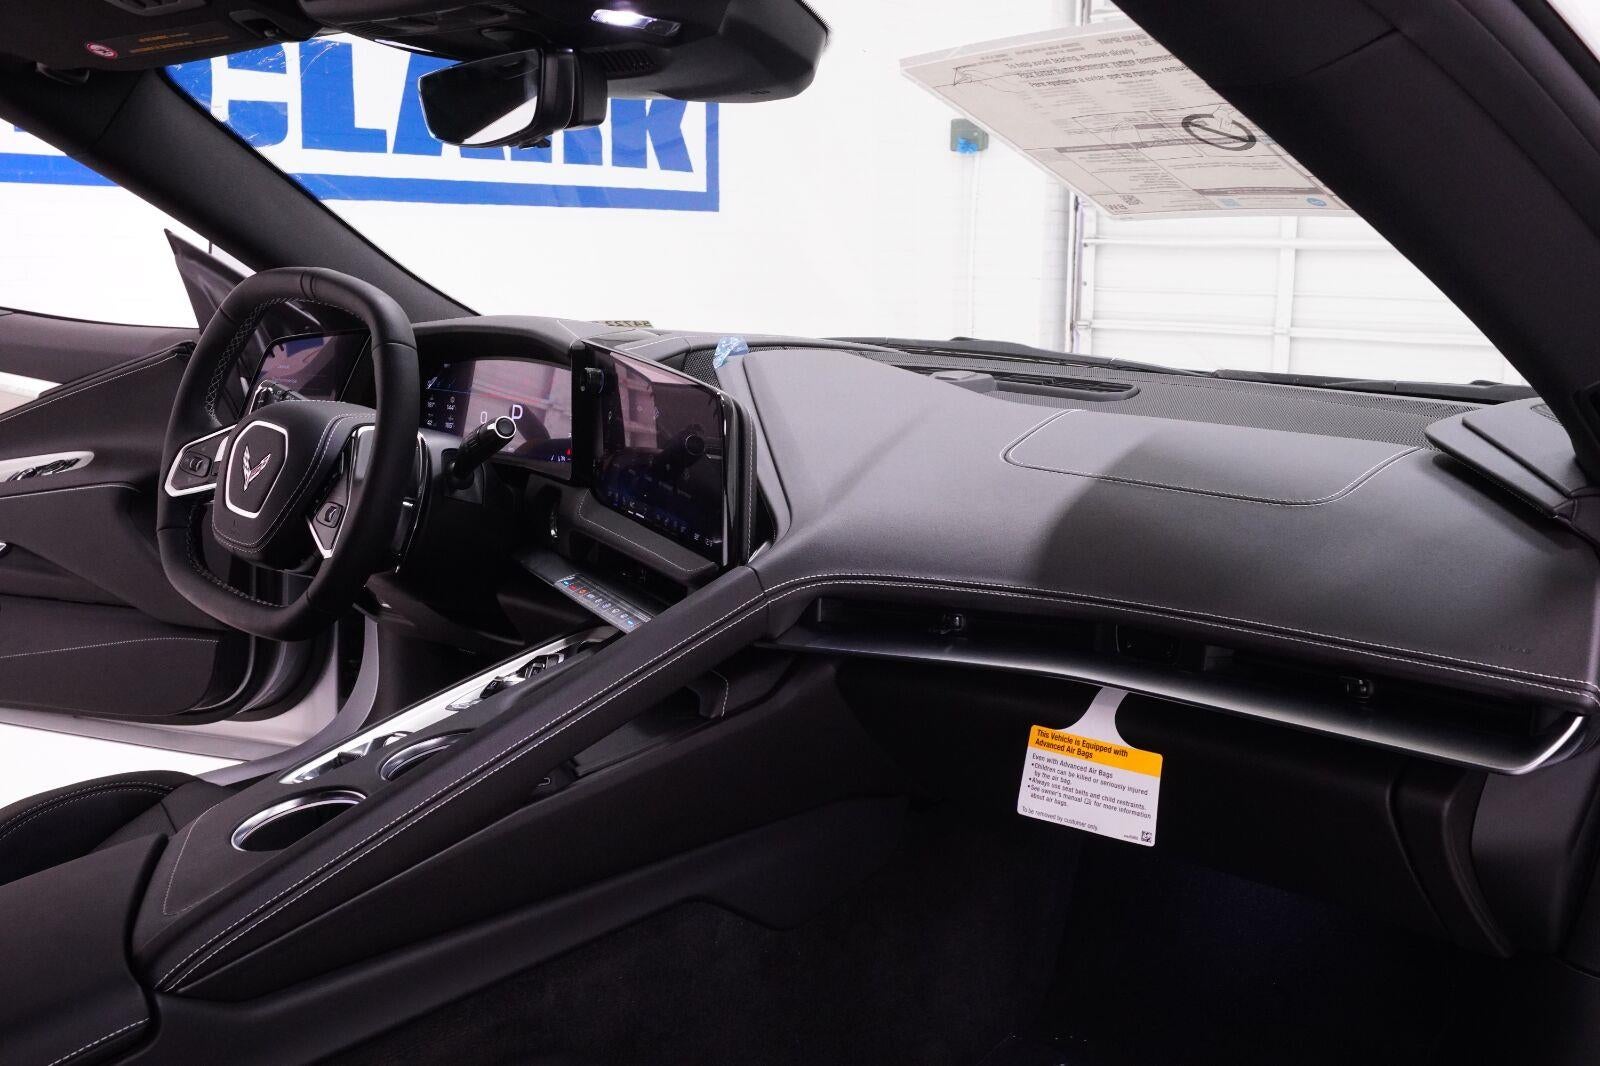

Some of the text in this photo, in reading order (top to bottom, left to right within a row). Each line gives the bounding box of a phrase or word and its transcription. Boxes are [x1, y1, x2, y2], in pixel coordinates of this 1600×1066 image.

[1035, 738, 1093, 759] Advanced Air Bags
[1037, 729, 1050, 738] This
[1051, 732, 1073, 745] Vehicle
[1082, 740, 1112, 754] Equipped
[1114, 748, 1128, 758] with
[1033, 753, 1045, 761] Even
[1060, 760, 1088, 772] Advanced
[1099, 770, 1113, 779] Bags
[1032, 778, 1050, 787] Always
[1075, 788, 1088, 796] belts
[1102, 795, 1115, 803] child
[1035, 763, 1055, 773] Children
[1077, 773, 1092, 782] killed
[1100, 780, 1126, 790] seriously
[1128, 786, 1148, 795] injured
[1031, 793, 1045, 801] about
[1041, 788, 1061, 798] owner's
[1063, 793, 1083, 802] manual
[1103, 803, 1117, 811] more
[1119, 807, 1151, 819] information
[1036, 810, 1056, 820] removed
[1064, 817, 1086, 827] customer
